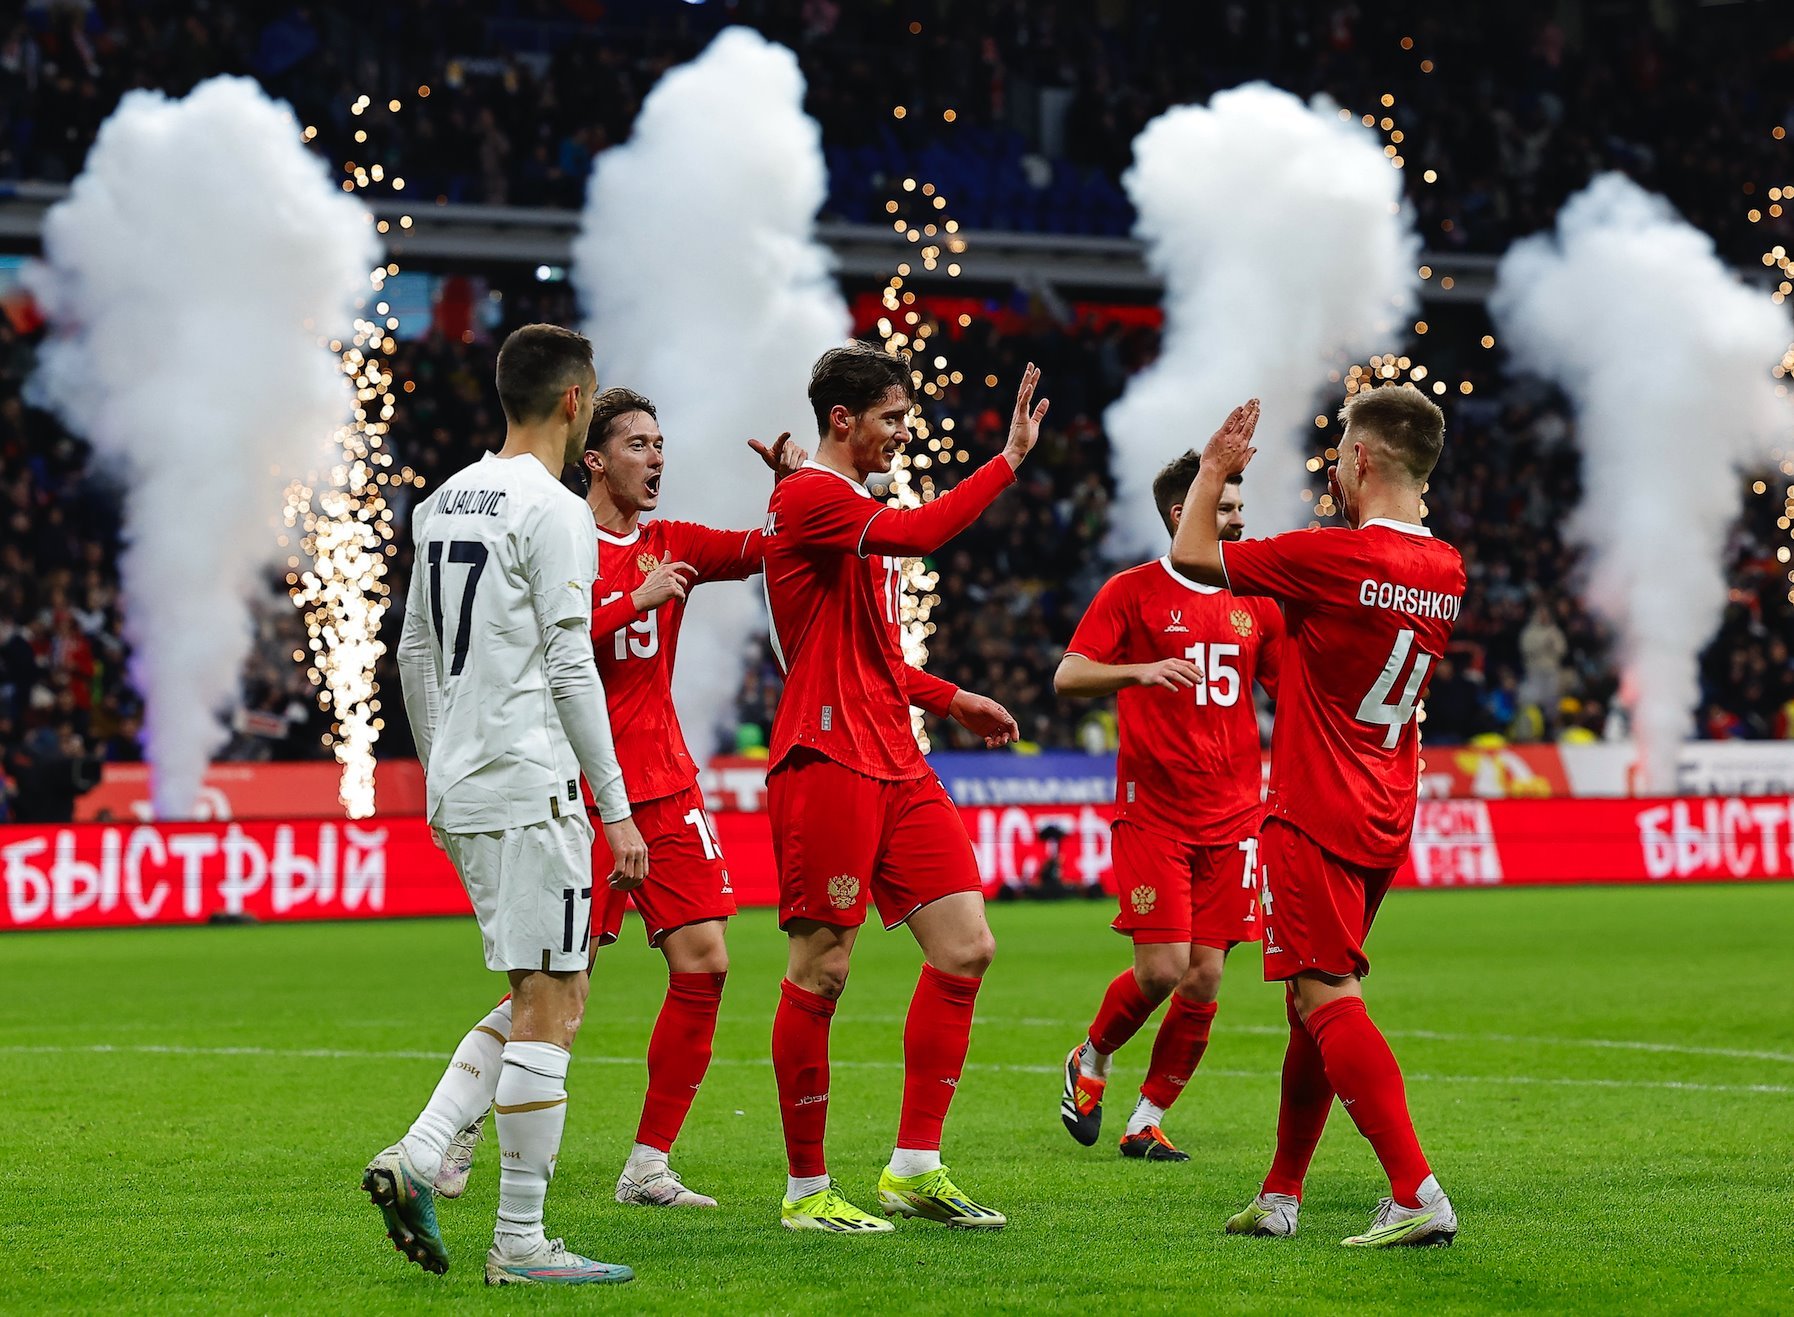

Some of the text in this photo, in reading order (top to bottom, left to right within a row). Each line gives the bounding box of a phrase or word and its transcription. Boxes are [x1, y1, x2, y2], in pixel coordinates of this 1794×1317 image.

[428, 540, 489, 676] 17
[601, 591, 659, 661] 19
[1359, 578, 1462, 622] GORSHKOV
[1184, 641, 1240, 707] 15
[1355, 628, 1431, 749] 4
[1, 823, 389, 924] БЫСТРЫЙ
[1635, 798, 1794, 878] БЫСТ
